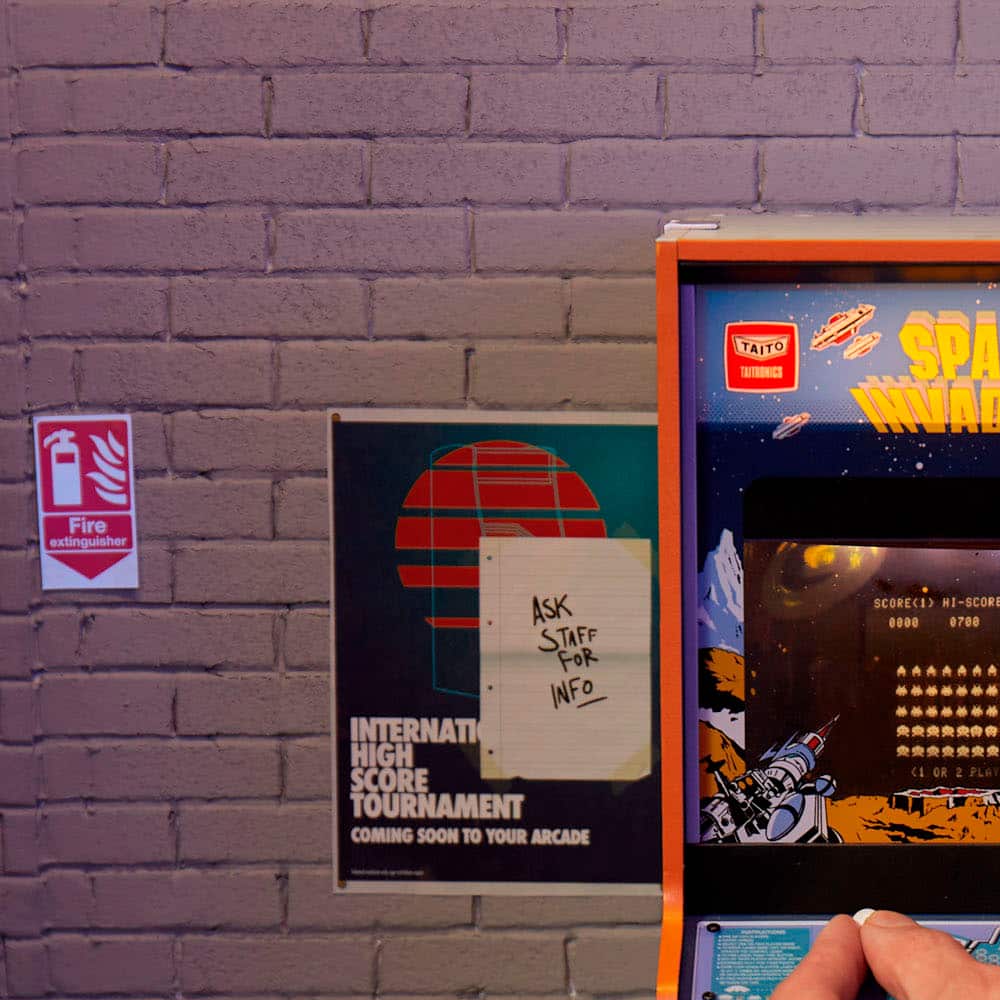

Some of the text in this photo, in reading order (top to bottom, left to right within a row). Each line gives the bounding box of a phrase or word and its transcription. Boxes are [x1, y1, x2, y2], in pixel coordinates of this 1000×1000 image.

[742, 341, 784, 355] TAITO
[740, 366, 783, 378] TAITRONICS
[69, 516, 107, 534] Fire
[49, 535, 127, 549] extinguisher
[532, 594, 573, 626] ASK
[538, 626, 597, 652] STAFF
[557, 647, 599, 672] FOR
[551, 677, 594, 709] INFO
[350, 717, 480, 743] INTERNATI
[350, 742, 414, 768] HIGH
[350, 768, 430, 793] SCORE
[933, 766, 948, 778] OR
[955, 766, 964, 778] 2
[350, 793, 525, 819] TOURNAMENT
[350, 827, 591, 845] COMING SOON TO YOUR ARCADE
